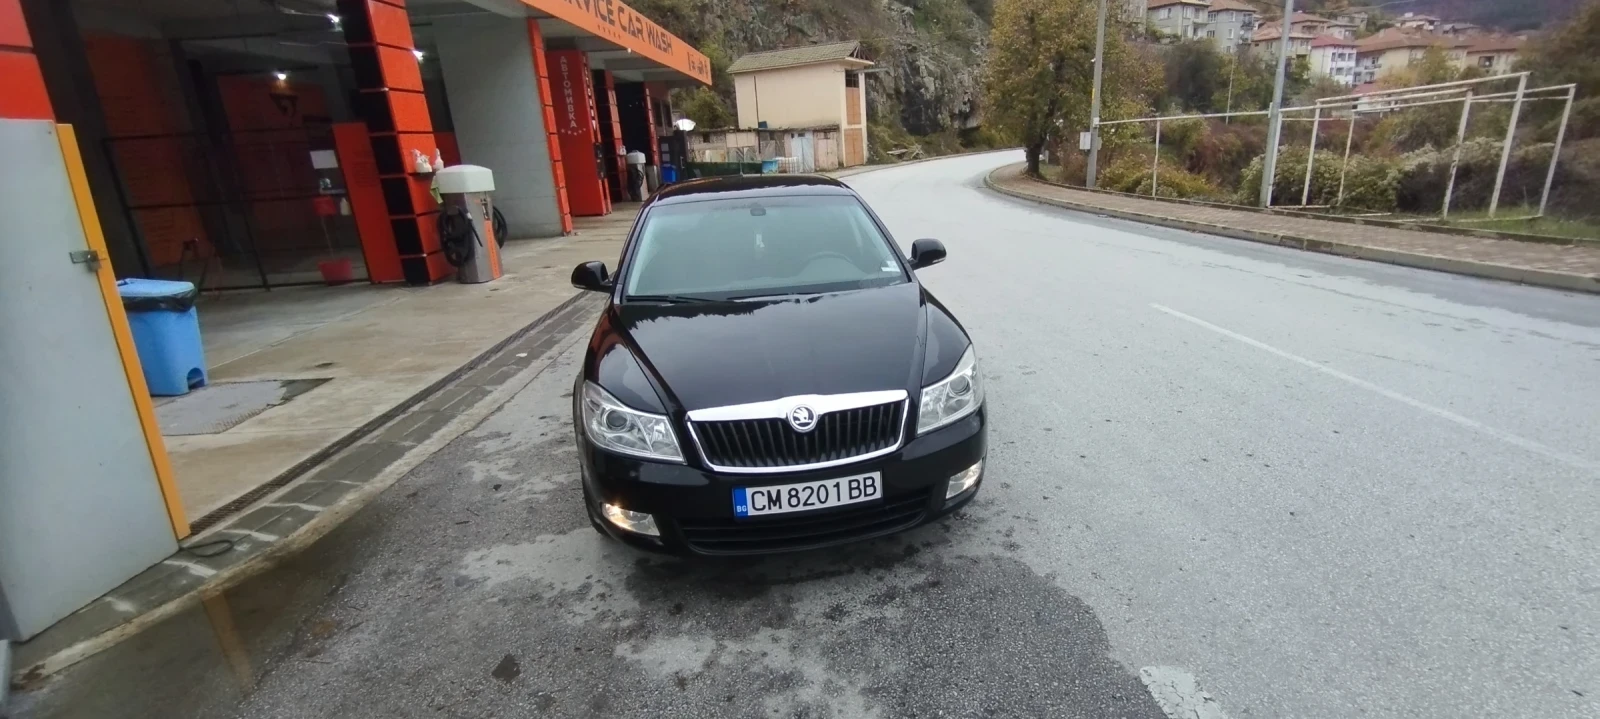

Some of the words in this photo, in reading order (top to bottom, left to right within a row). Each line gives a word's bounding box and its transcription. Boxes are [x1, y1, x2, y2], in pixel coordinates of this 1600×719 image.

[617, 6, 645, 42] CAR
[645, 22, 673, 56] WASH
[560, 56, 577, 128] АВТОМИВКА
[751, 489, 782, 511] CM
[787, 481, 841, 508] 8201
[848, 476, 877, 500] BB
